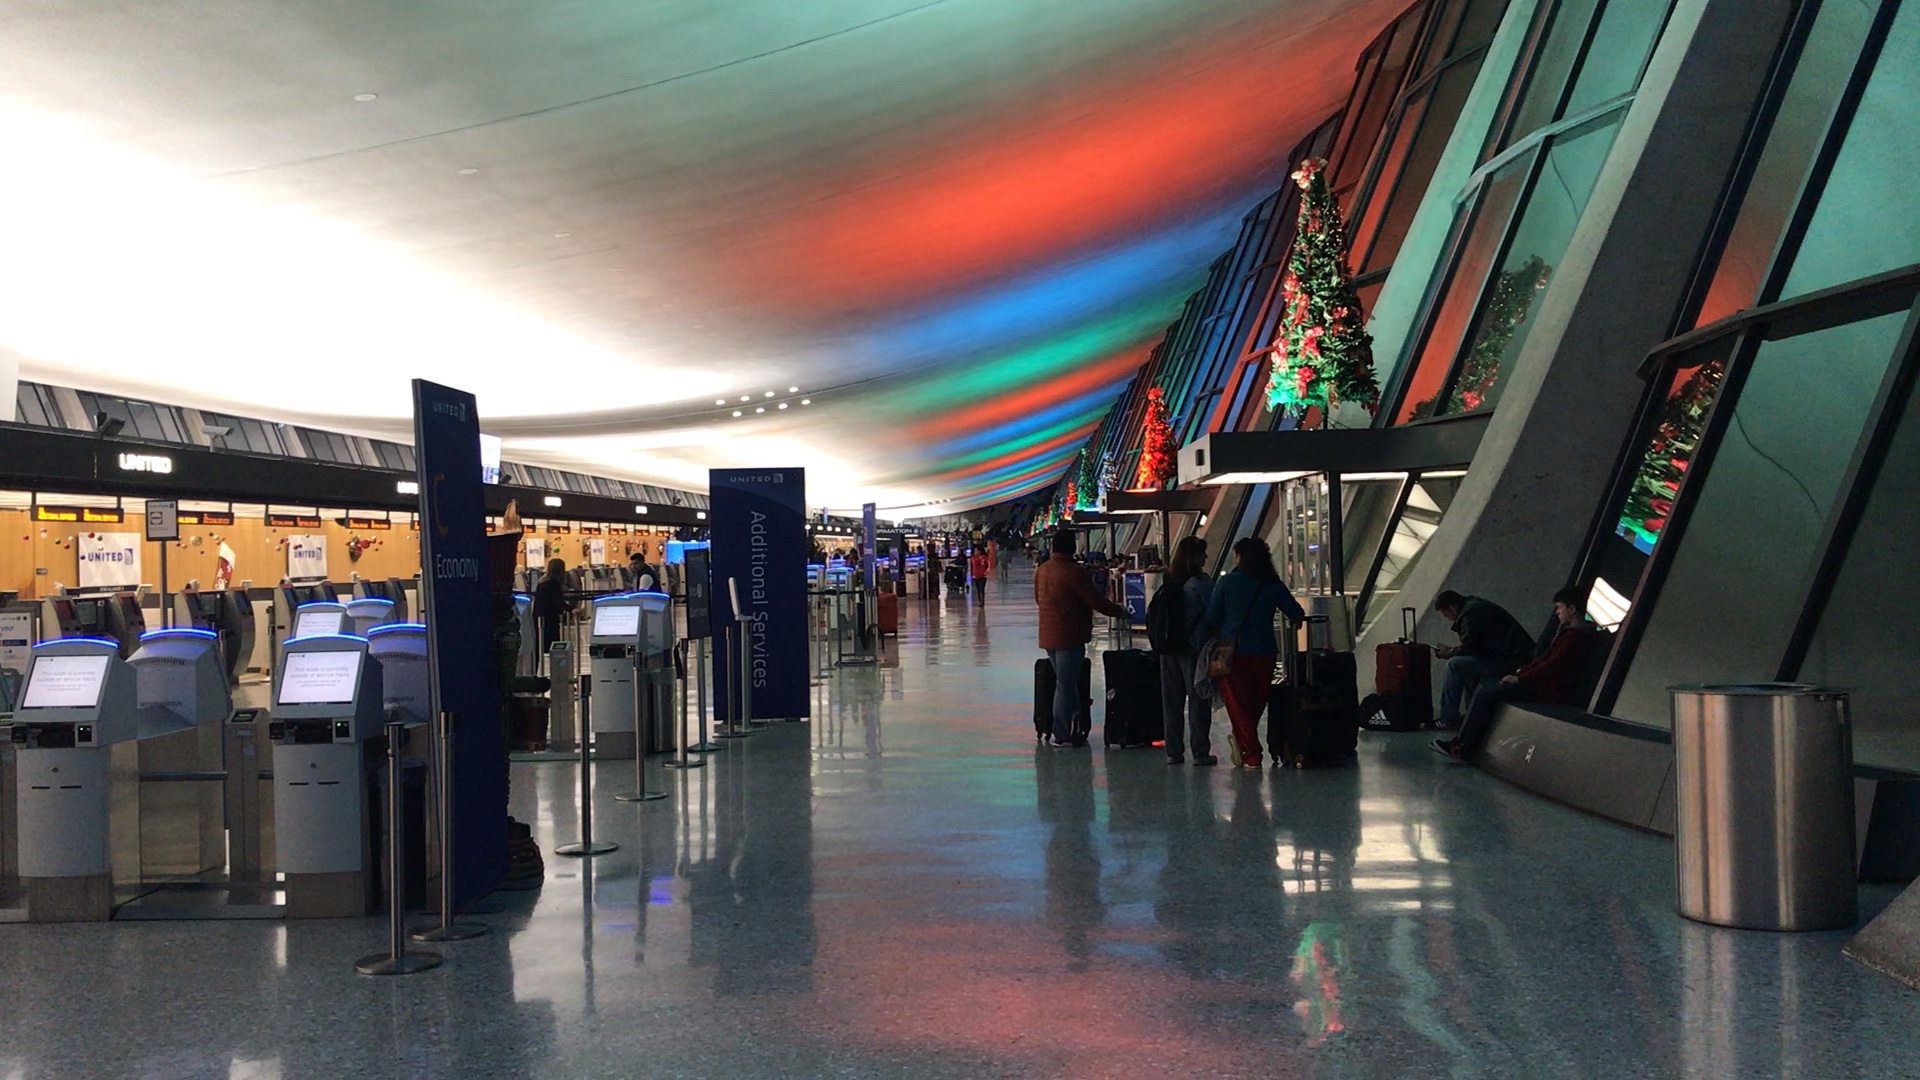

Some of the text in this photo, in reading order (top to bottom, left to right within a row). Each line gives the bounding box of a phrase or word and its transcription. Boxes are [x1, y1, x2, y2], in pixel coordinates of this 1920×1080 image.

[432, 400, 459, 417] UNITED
[119, 452, 172, 474] UNITED
[730, 475, 772, 483] UNITED
[87, 552, 123, 562] UNITED
[294, 550, 316, 558] UNITED
[436, 554, 479, 581] Economy
[750, 510, 769, 688] Additional Services
